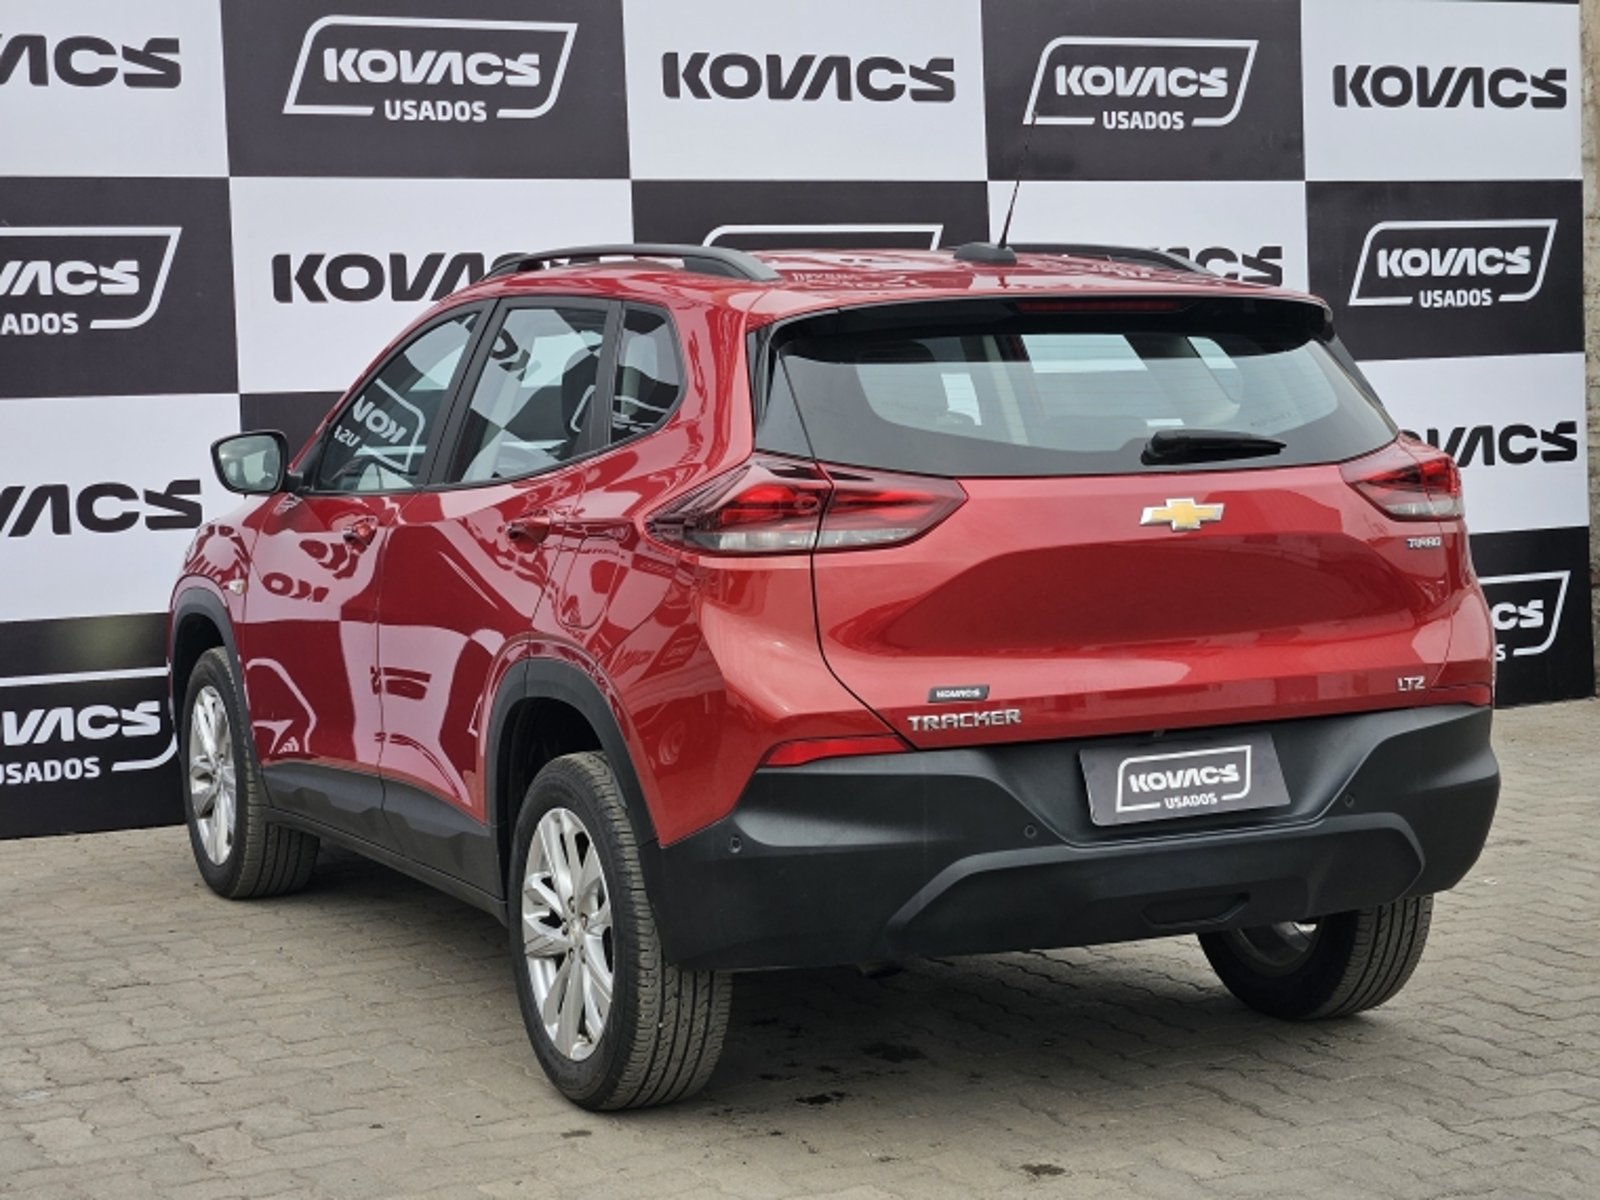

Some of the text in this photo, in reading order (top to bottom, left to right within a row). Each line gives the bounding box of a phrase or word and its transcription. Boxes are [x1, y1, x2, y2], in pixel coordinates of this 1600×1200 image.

[0, 34, 181, 88] ACS
[324, 48, 540, 86] KOVACS
[662, 52, 955, 102] KOVACS
[1056, 66, 1227, 97] KOVACS
[1333, 65, 1566, 109] KOVACS
[385, 100, 486, 123] USADOS
[1103, 110, 1184, 130] USADOS
[1378, 247, 1530, 277] KOVACS
[272, 253, 526, 303] KOVA
[1420, 289, 1492, 308] USADOS
[0, 312, 79, 335] ADOS
[1402, 421, 1577, 467] VACS
[1397, 675, 1426, 691] LTZ
[2, 700, 161, 746] VACS
[907, 709, 1022, 731] TRACKER
[0, 757, 101, 785] SADOS
[1129, 763, 1240, 792] KOVACS
[1164, 793, 1218, 809] USADOS
